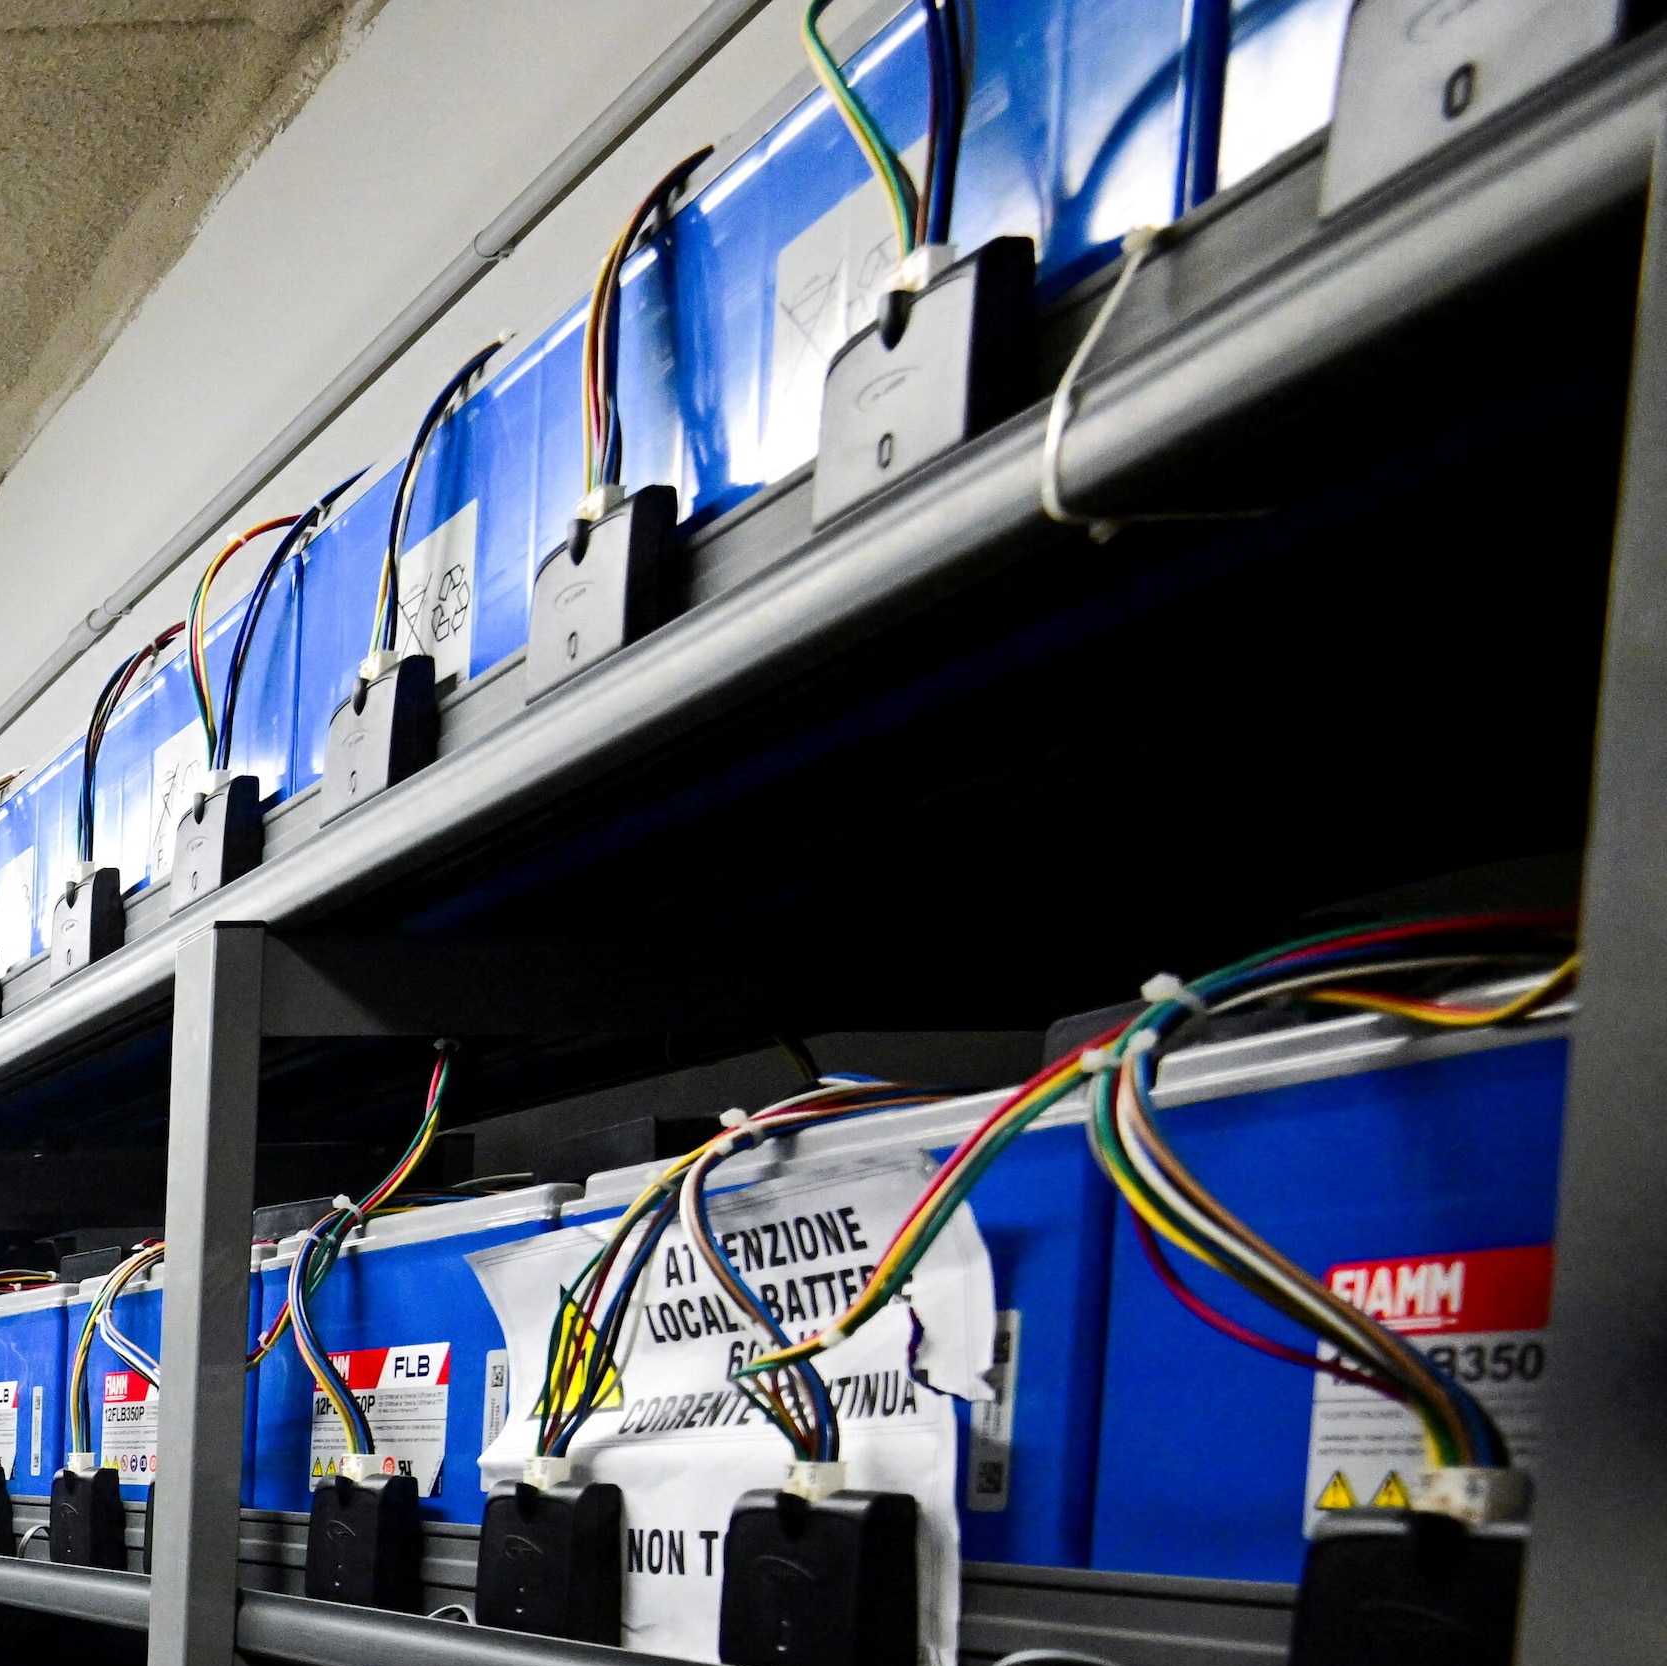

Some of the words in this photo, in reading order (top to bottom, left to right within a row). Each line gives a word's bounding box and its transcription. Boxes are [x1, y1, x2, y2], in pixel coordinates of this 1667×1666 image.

[665, 1206, 869, 1288] ATENZIONE
[1329, 1259, 1466, 1320] FIAMM
[394, 1355, 431, 1379] FLB
[104, 1374, 129, 1397] FIAMM
[104, 1405, 145, 1423] 12FLB350P
[627, 1528, 686, 1576] NON
